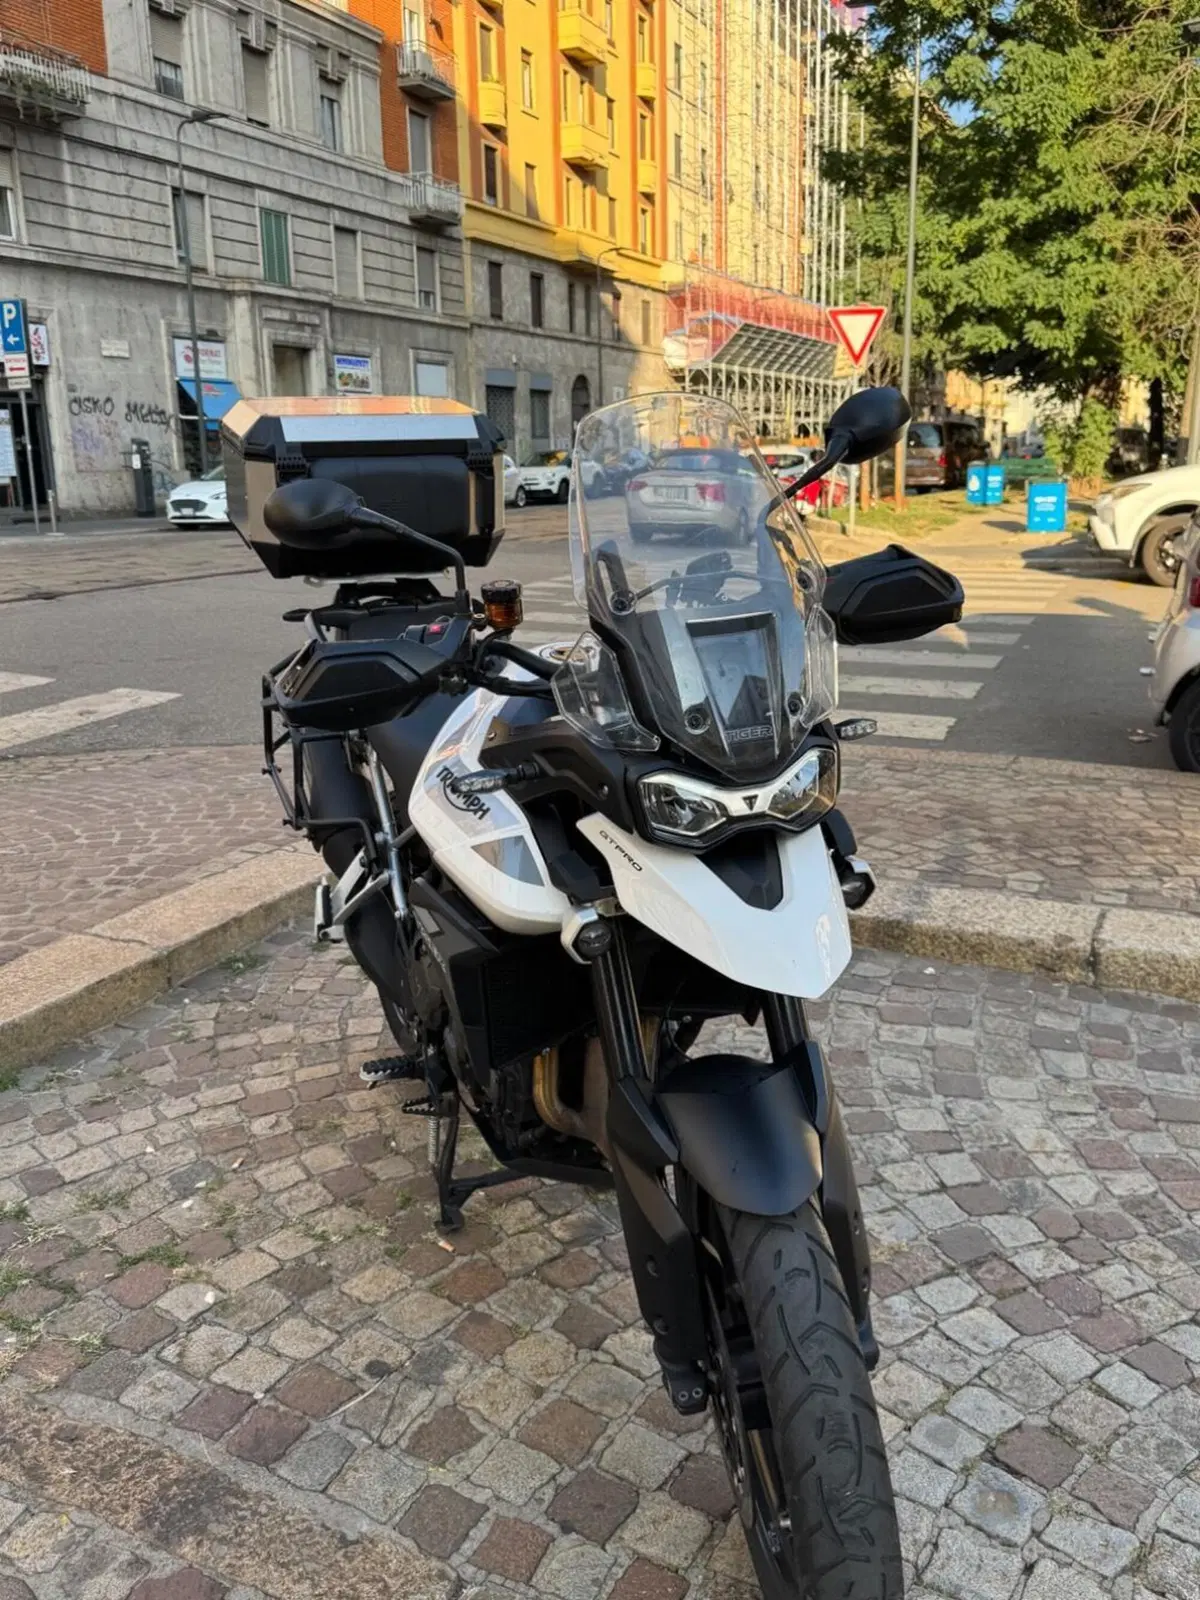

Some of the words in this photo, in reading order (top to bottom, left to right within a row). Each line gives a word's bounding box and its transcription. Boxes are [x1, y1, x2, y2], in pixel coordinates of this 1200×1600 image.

[3, 303, 17, 328] P
[722, 724, 774, 742] TIGER
[436, 766, 491, 820] TRIMPH
